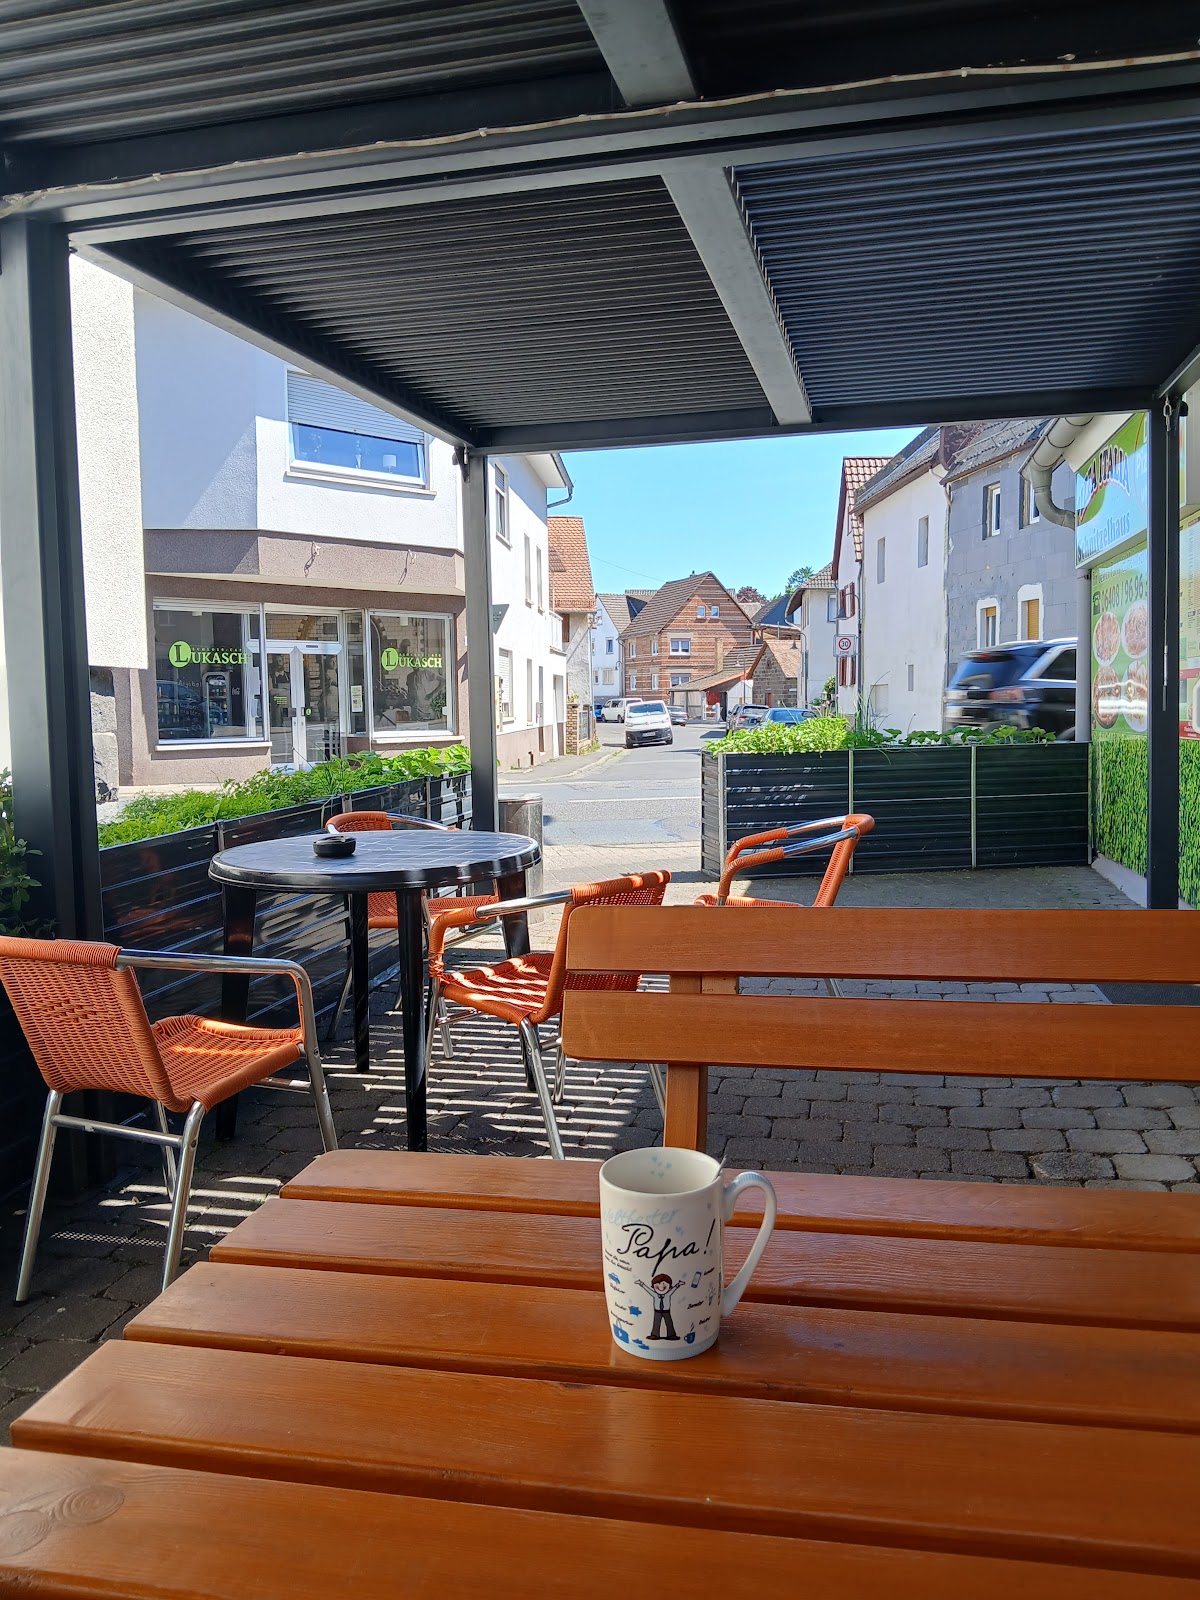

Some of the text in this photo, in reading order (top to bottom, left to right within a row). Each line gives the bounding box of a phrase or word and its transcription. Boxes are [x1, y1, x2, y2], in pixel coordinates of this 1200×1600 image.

[1098, 443, 1131, 497] ITALIA
[1077, 511, 1131, 562] Schnitzelhaus
[1124, 577, 1133, 605] 96
[1134, 572, 1144, 601] 96
[173, 644, 248, 664] LUKASCH
[385, 650, 442, 668] LUKASCH
[616, 1218, 716, 1277] Papa!
